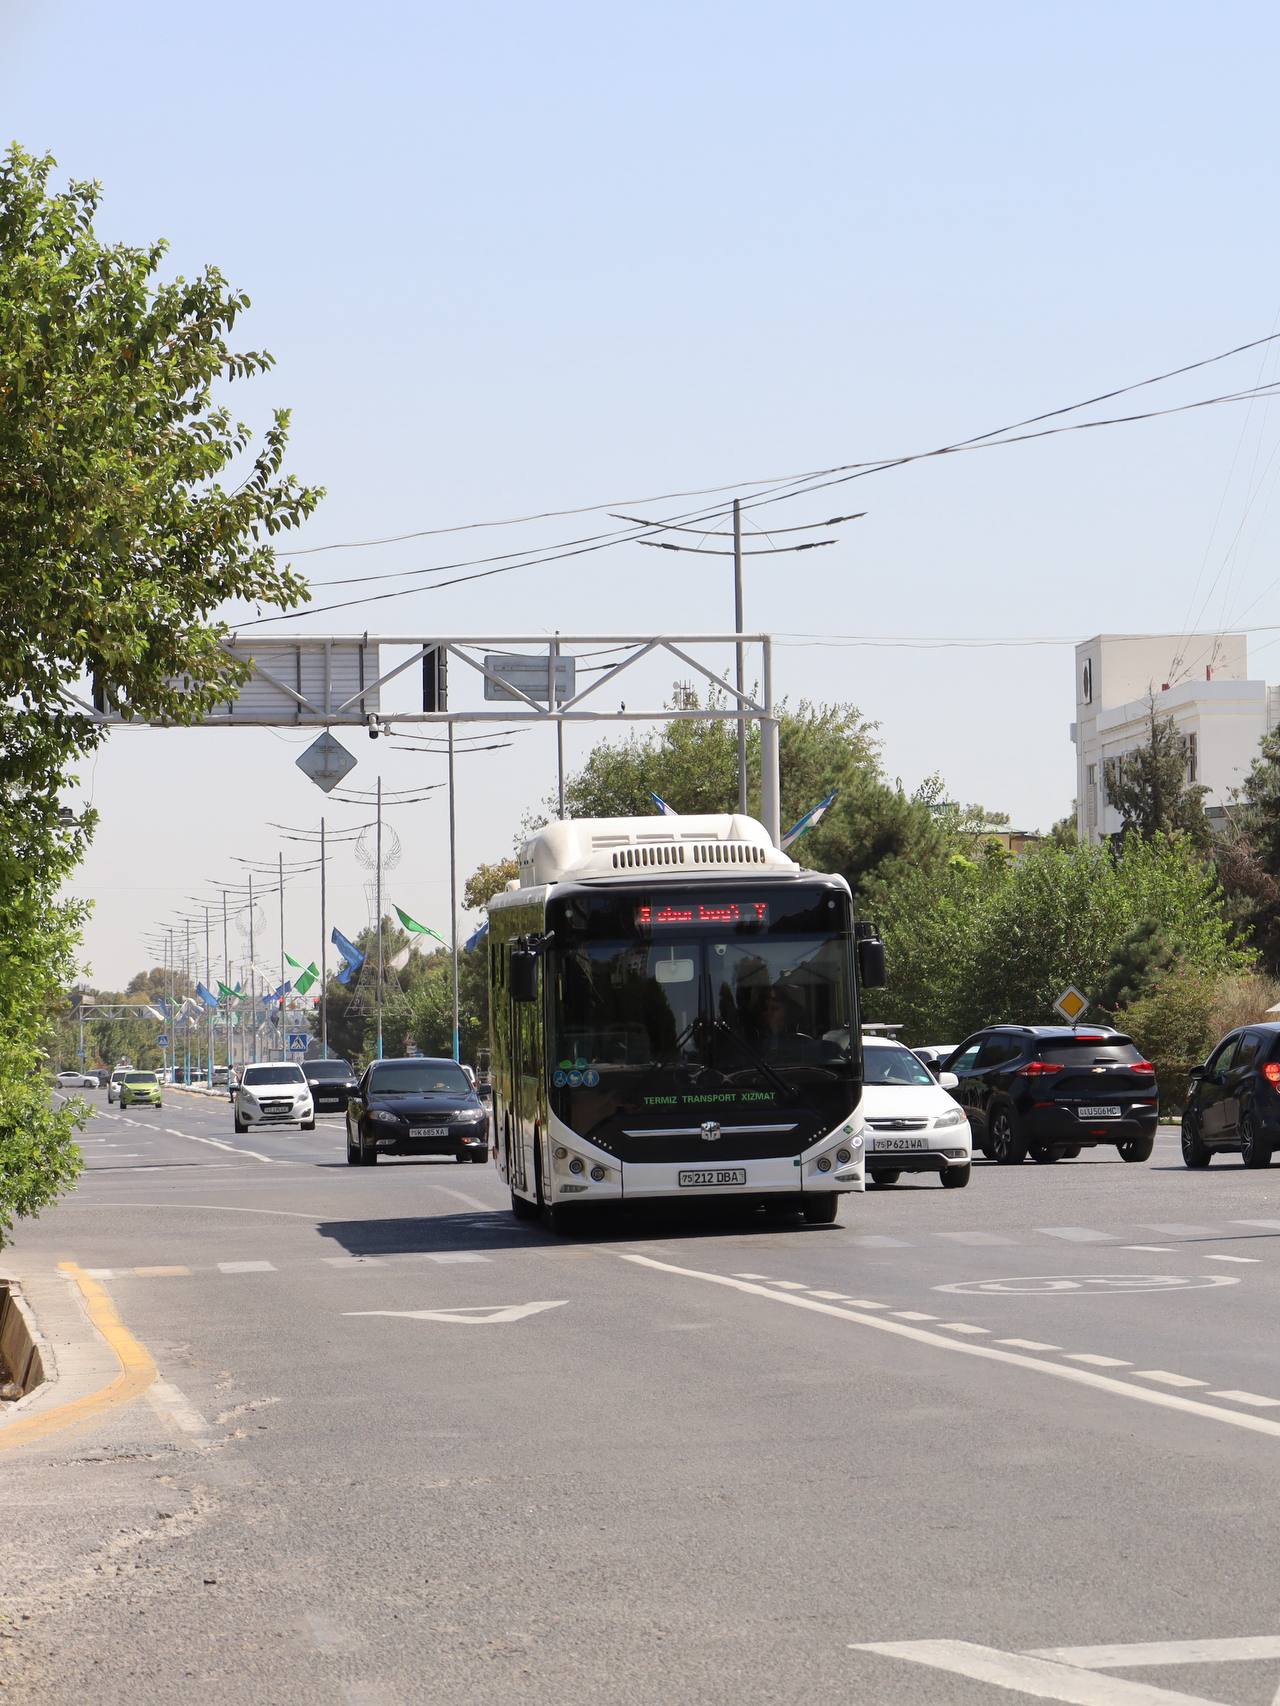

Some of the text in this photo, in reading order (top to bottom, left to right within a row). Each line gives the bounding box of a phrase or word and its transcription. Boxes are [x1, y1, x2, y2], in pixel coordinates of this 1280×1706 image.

[643, 1092, 776, 1105] TERMIZ TRANSPORT XIZMAT
[682, 1171, 739, 1184] 75 212 DBA
